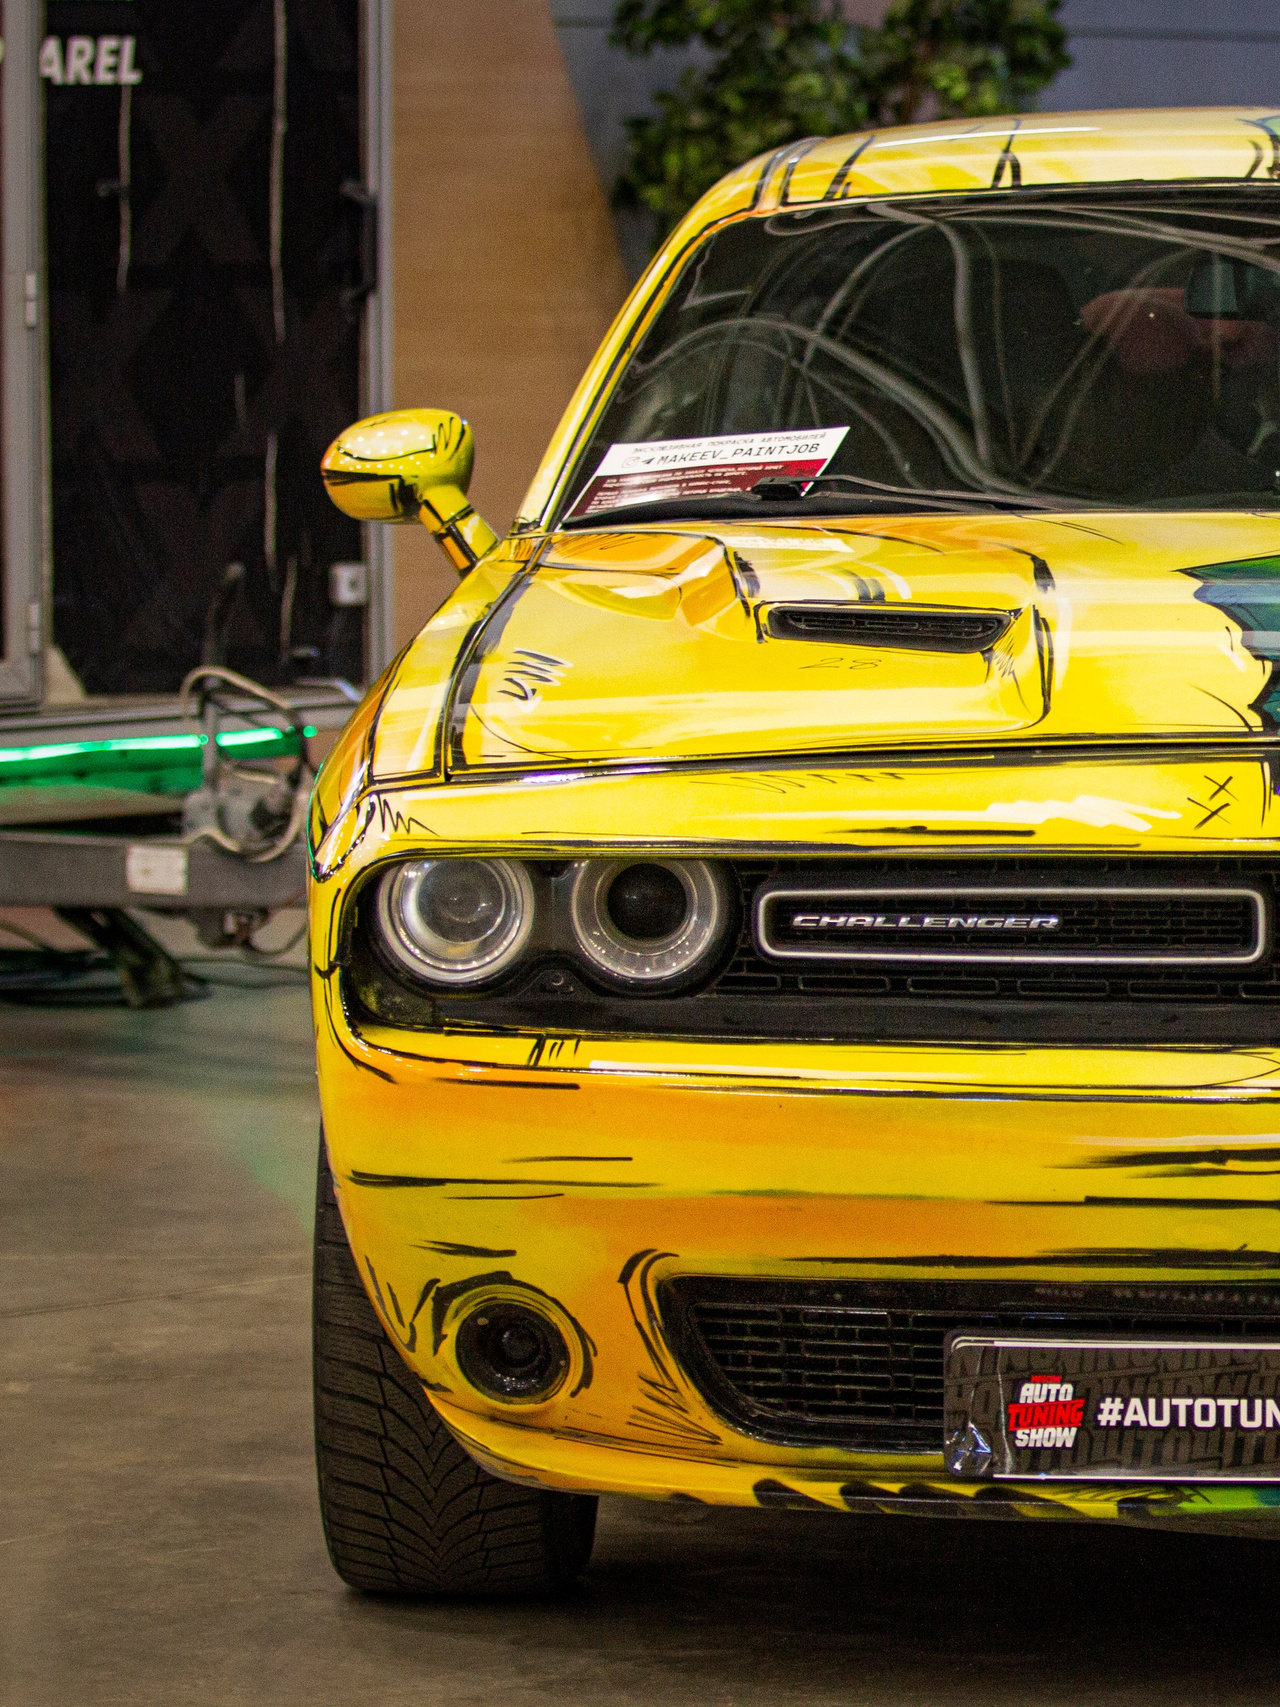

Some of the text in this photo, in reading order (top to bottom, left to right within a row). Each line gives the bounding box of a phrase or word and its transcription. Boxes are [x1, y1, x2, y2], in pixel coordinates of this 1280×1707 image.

[39, 34, 143, 86] AREL
[707, 438, 754, 447] ПОКРАСКА
[760, 431, 827, 443] АВТОМОБИЛЕЙ
[657, 442, 821, 465] MAKEEV_PAINTJOB
[792, 915, 1060, 930] CHALLENGER
[1019, 1382, 1074, 1404] AUTO
[1008, 1402, 1084, 1428] TUNING
[1015, 1427, 1077, 1448] SHOW
